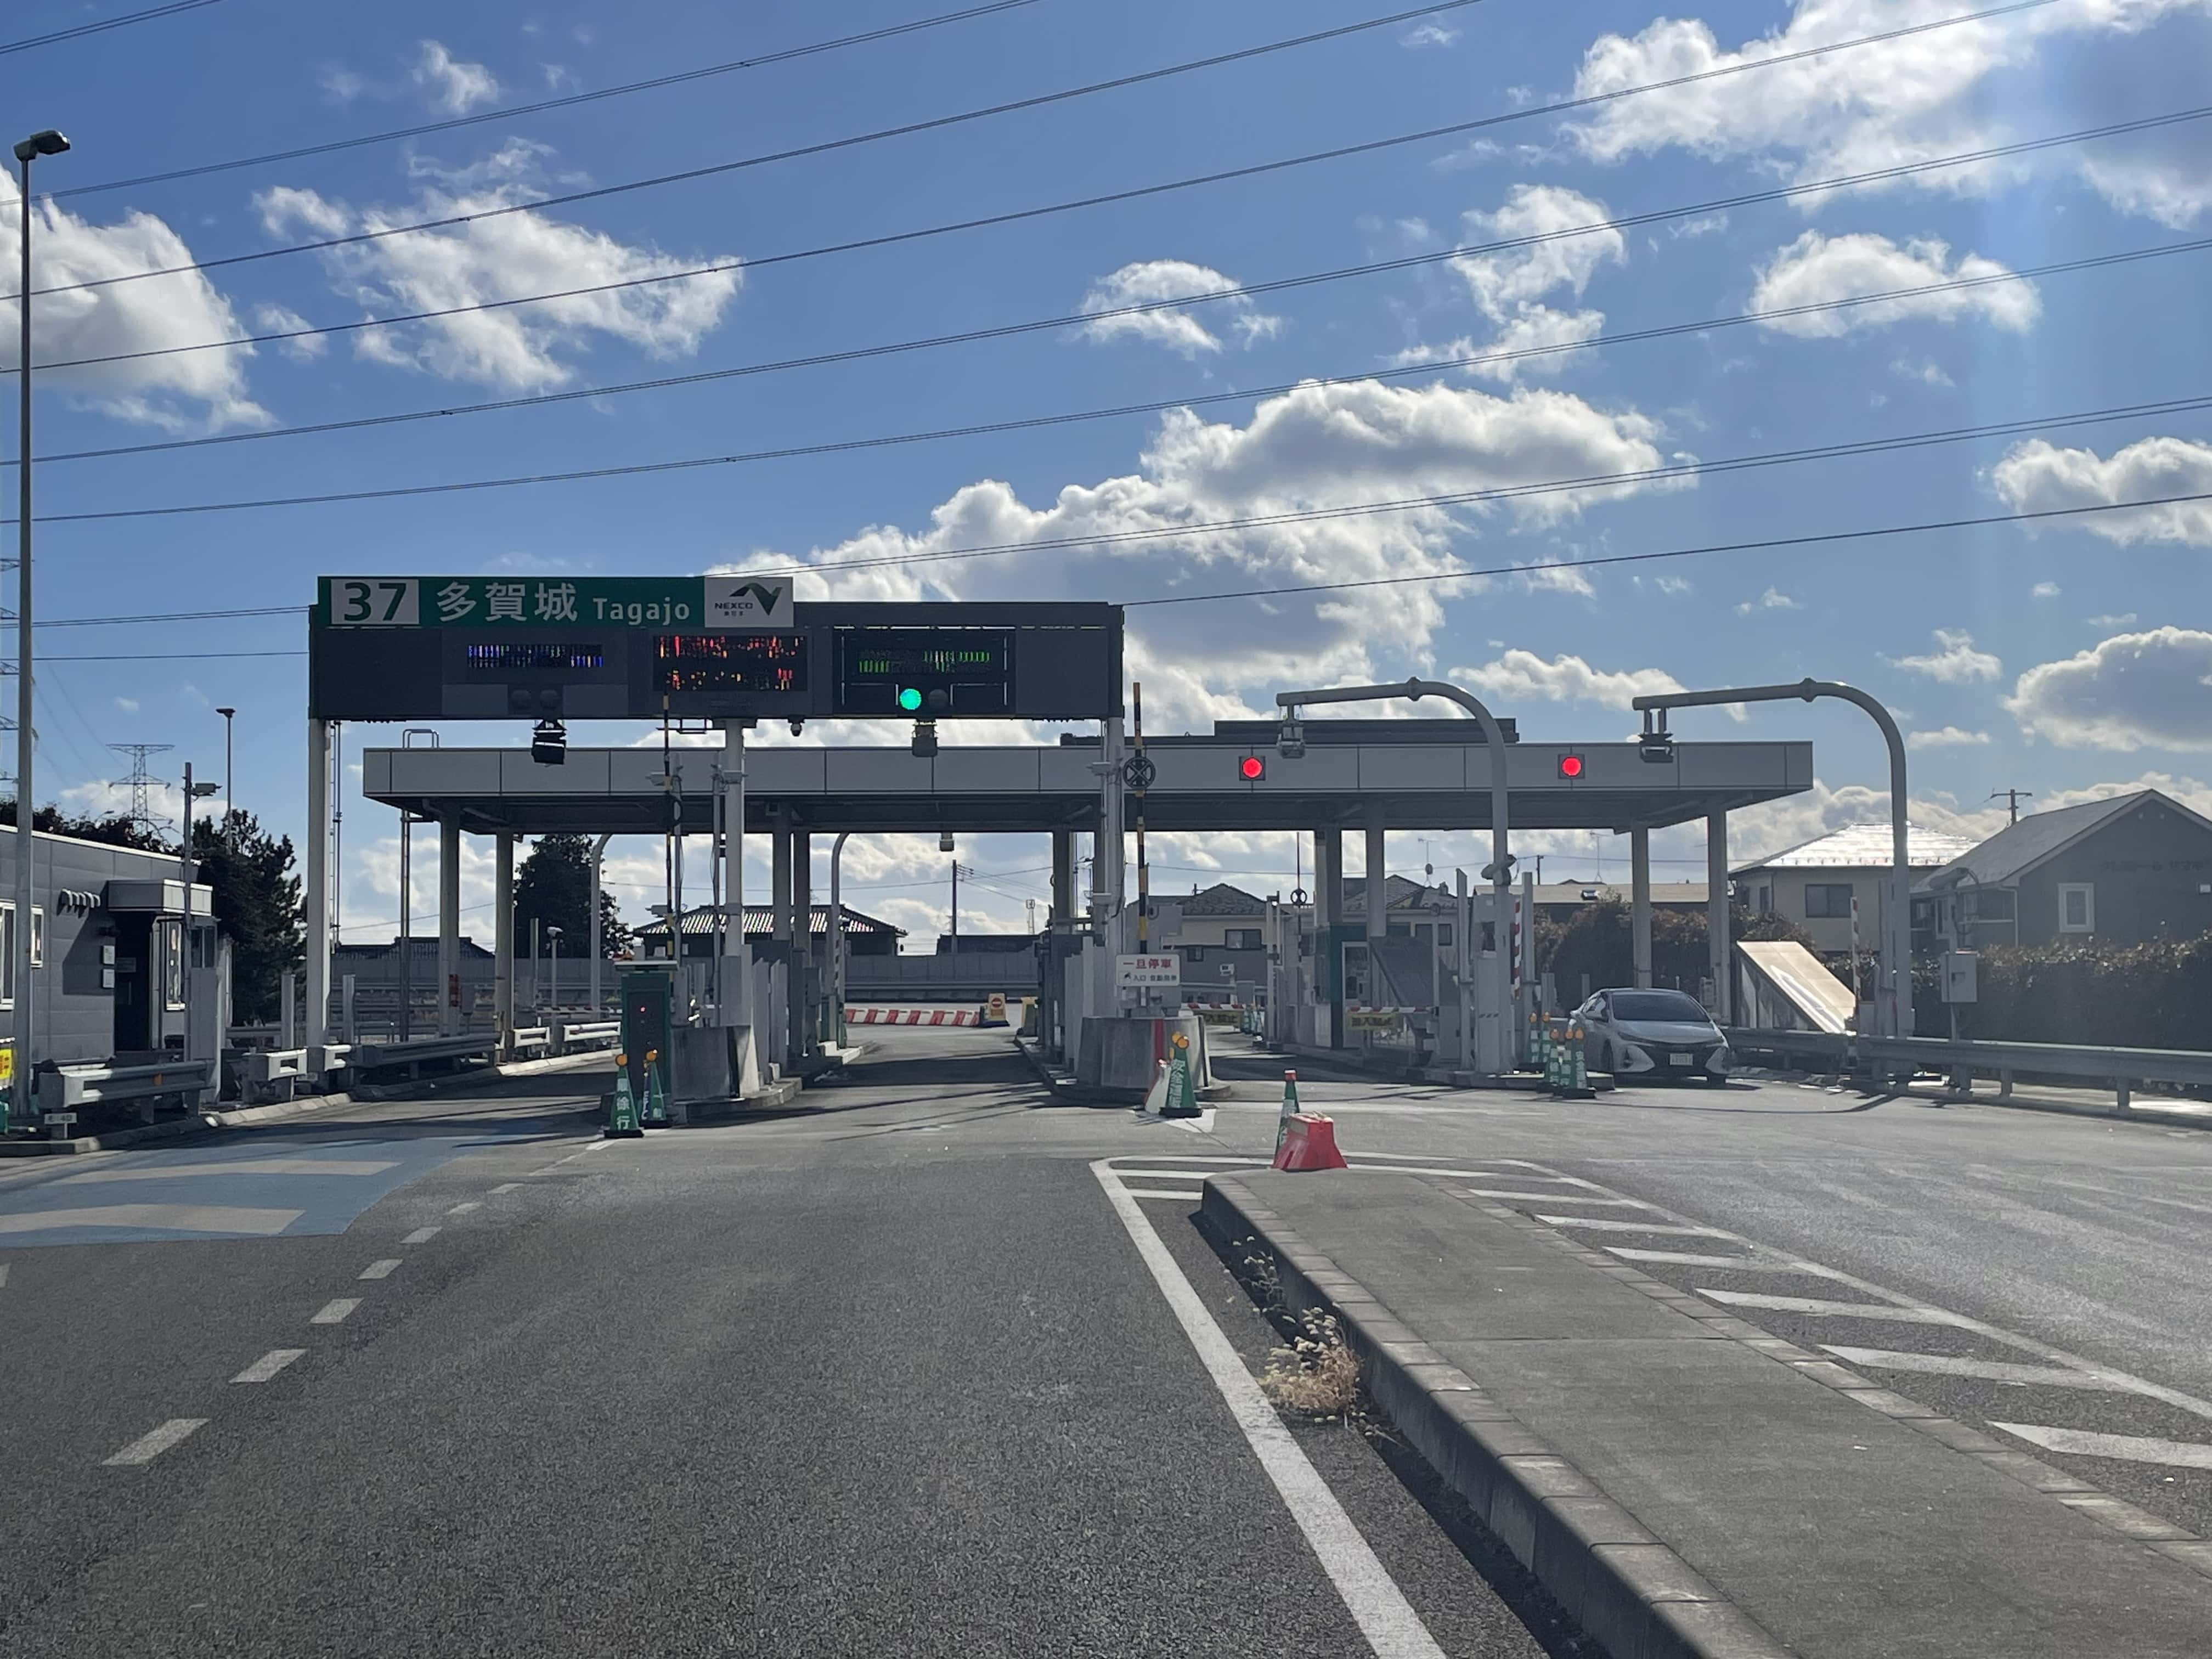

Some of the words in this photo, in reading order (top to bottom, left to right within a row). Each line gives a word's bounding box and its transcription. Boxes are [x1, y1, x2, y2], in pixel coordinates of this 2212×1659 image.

[342, 582, 407, 622] 37
[437, 582, 578, 622] 多賀城
[592, 597, 690, 625] Tagajo
